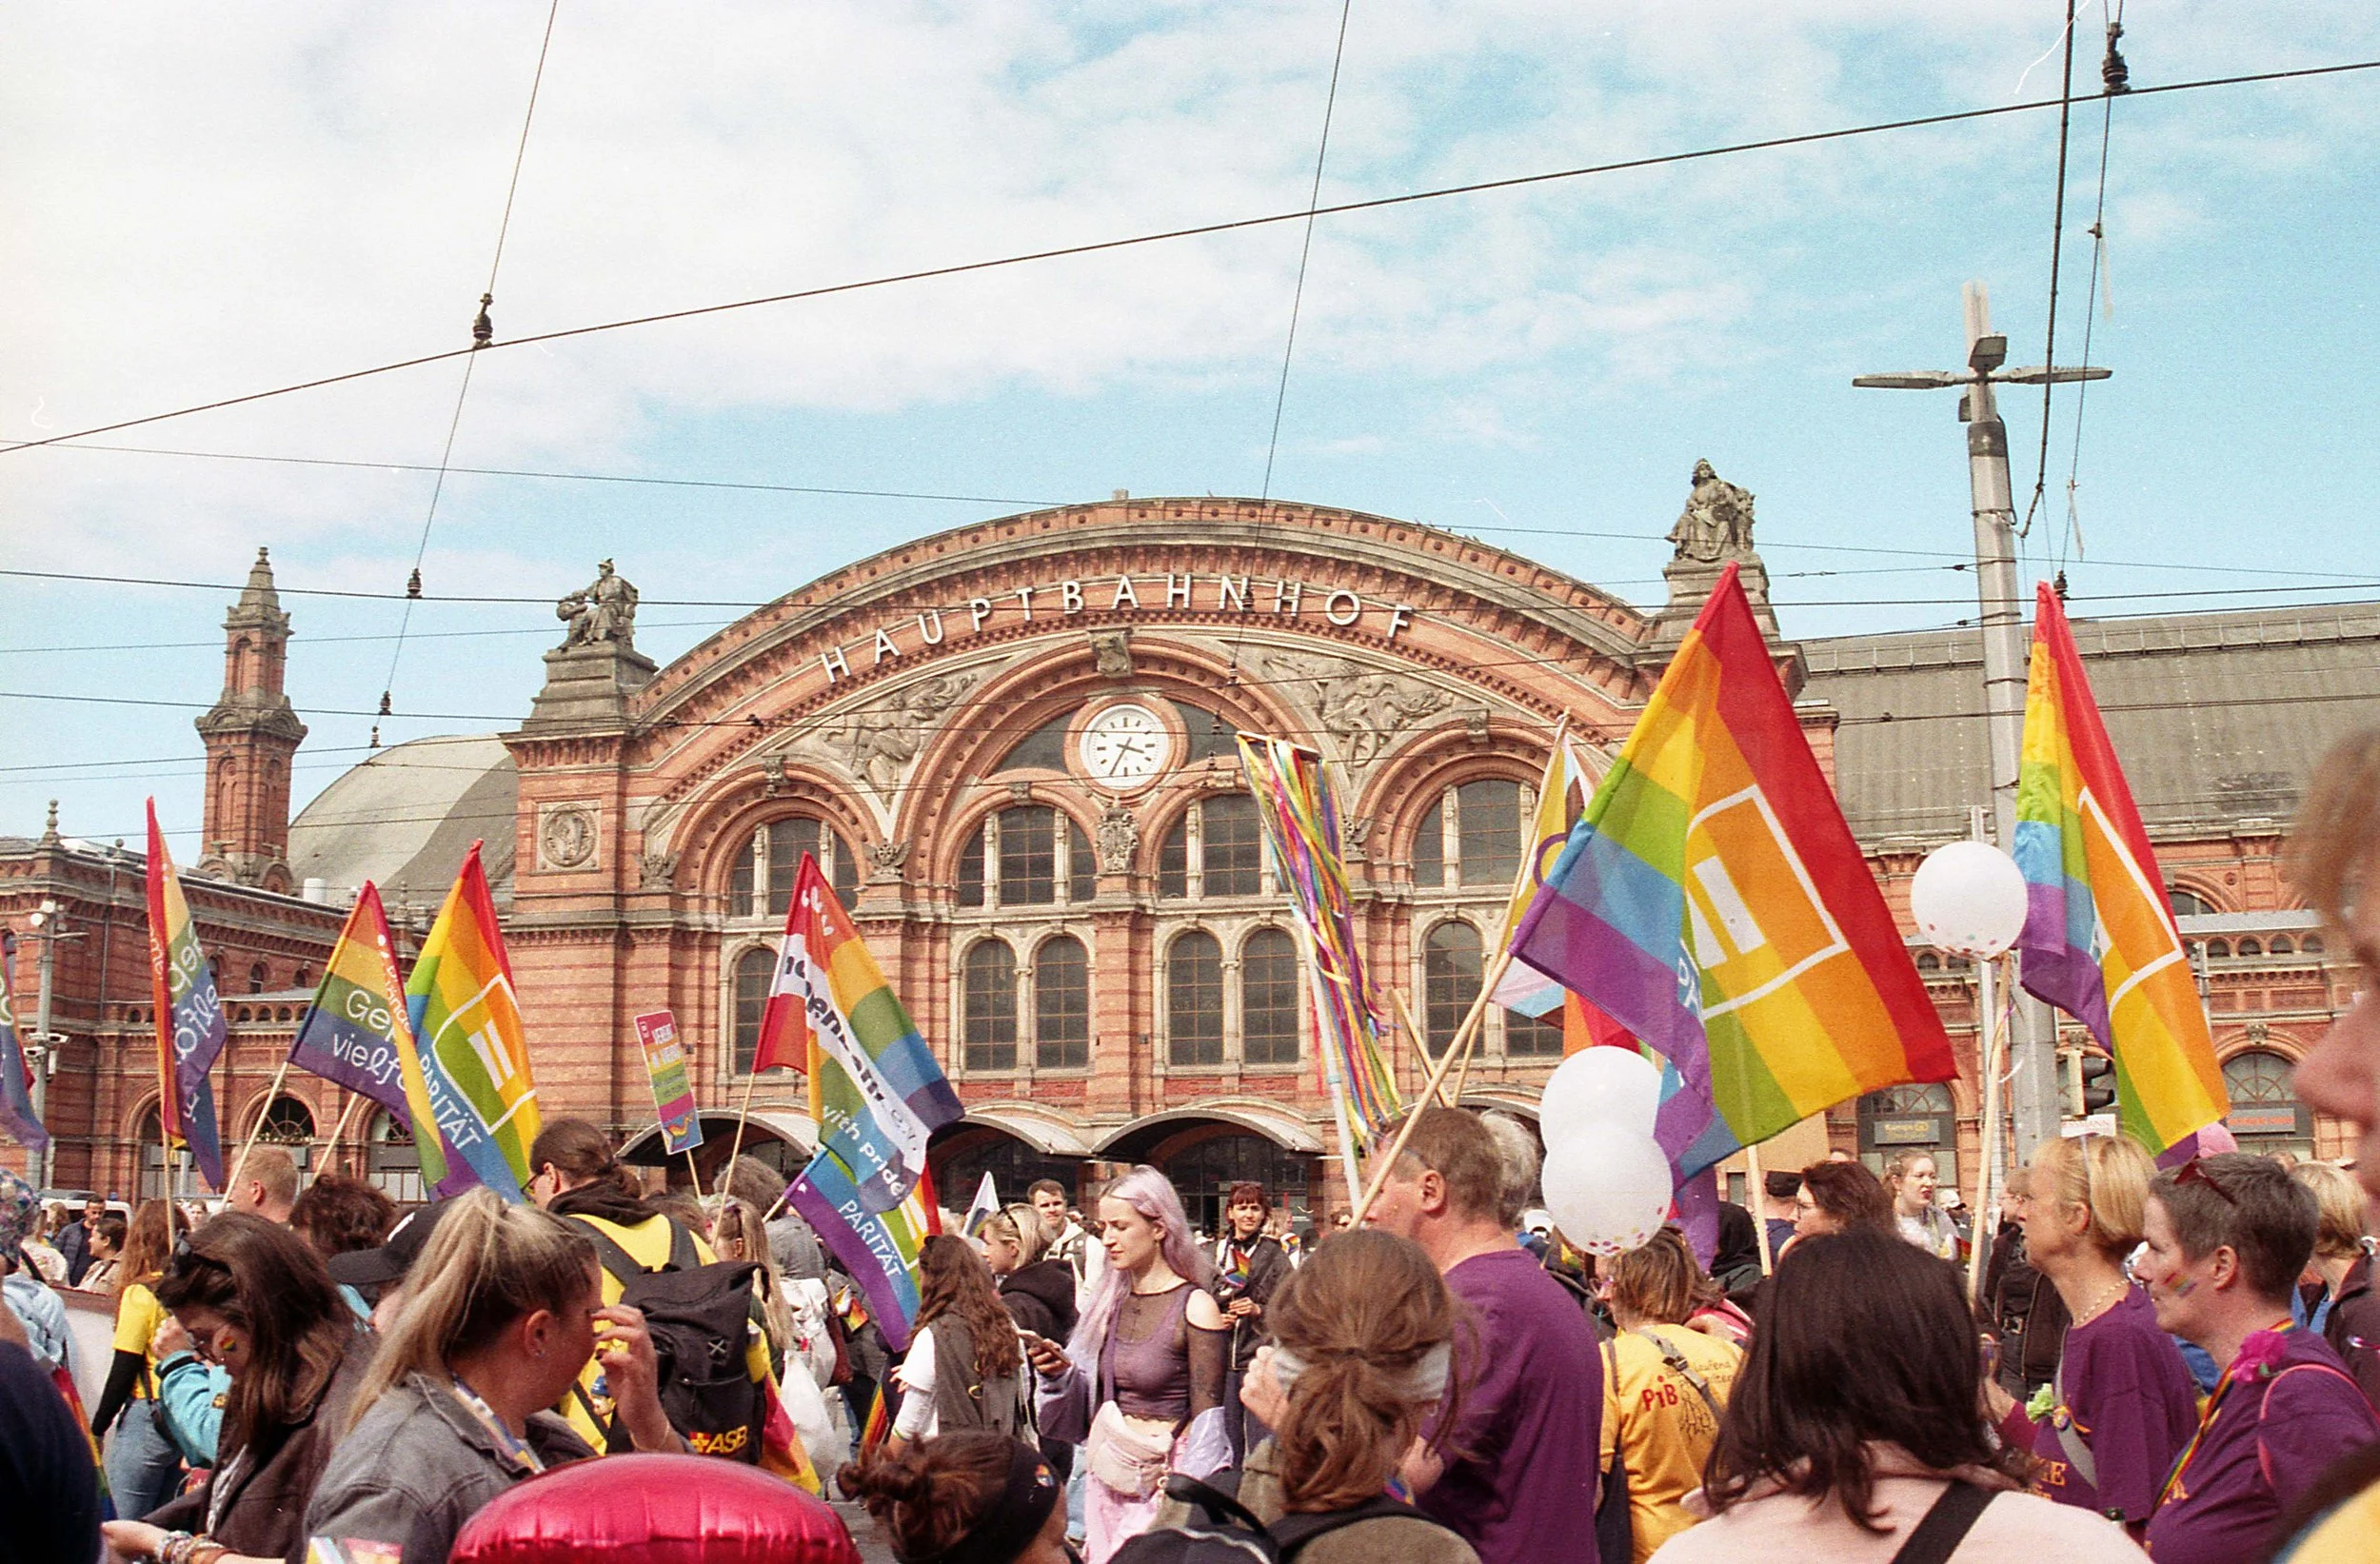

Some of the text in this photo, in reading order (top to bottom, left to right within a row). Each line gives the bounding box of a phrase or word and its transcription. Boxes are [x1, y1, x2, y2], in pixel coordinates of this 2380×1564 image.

[821, 574, 1414, 684] HAUPTBAHNHOF
[420, 1054, 483, 1150] PARITÄT
[838, 1199, 902, 1277] PARITÄT
[1641, 1375, 1678, 1412] PiB
[705, 1425, 748, 1455] ASB
